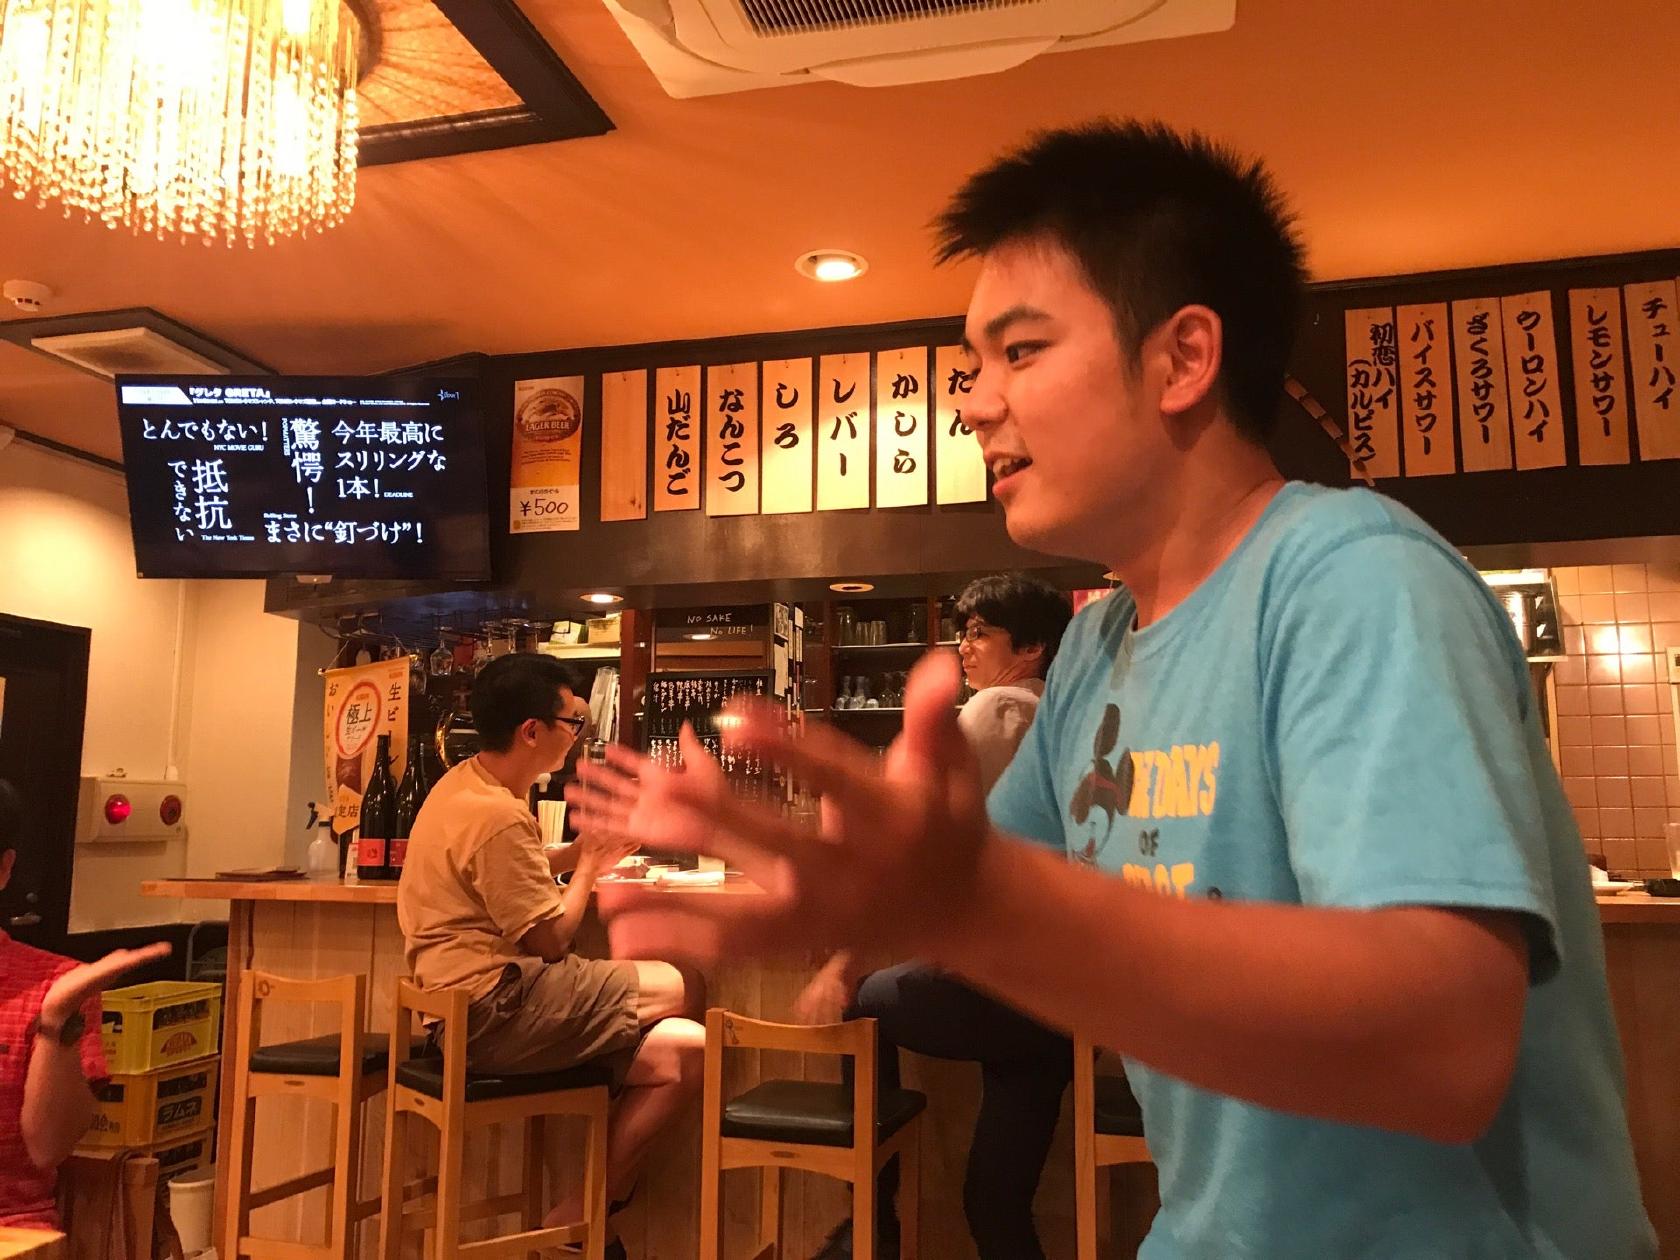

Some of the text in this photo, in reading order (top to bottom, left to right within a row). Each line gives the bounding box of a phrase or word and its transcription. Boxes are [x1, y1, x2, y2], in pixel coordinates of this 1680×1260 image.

[1369, 323, 1396, 410] 初恋ハイ
[1410, 320, 1436, 455] バイスサワー
[1466, 312, 1495, 443] ざくろサワー
[1516, 311, 1550, 442] ウーロンハイ
[1586, 304, 1615, 437] レモンサワー
[1642, 297, 1676, 410] チューハイ
[142, 418, 268, 442] とんでもない！
[331, 419, 444, 445] 今年最高に
[335, 449, 447, 472] スリリングな
[667, 389, 691, 496] 山だんご
[719, 389, 745, 492] なんこつ
[774, 382, 799, 449] しろ
[831, 379, 857, 476] レバー
[892, 374, 919, 473] かしら
[167, 460, 194, 542] できない
[191, 458, 232, 530] 抵抗
[520, 498, 569, 517] ¥500
